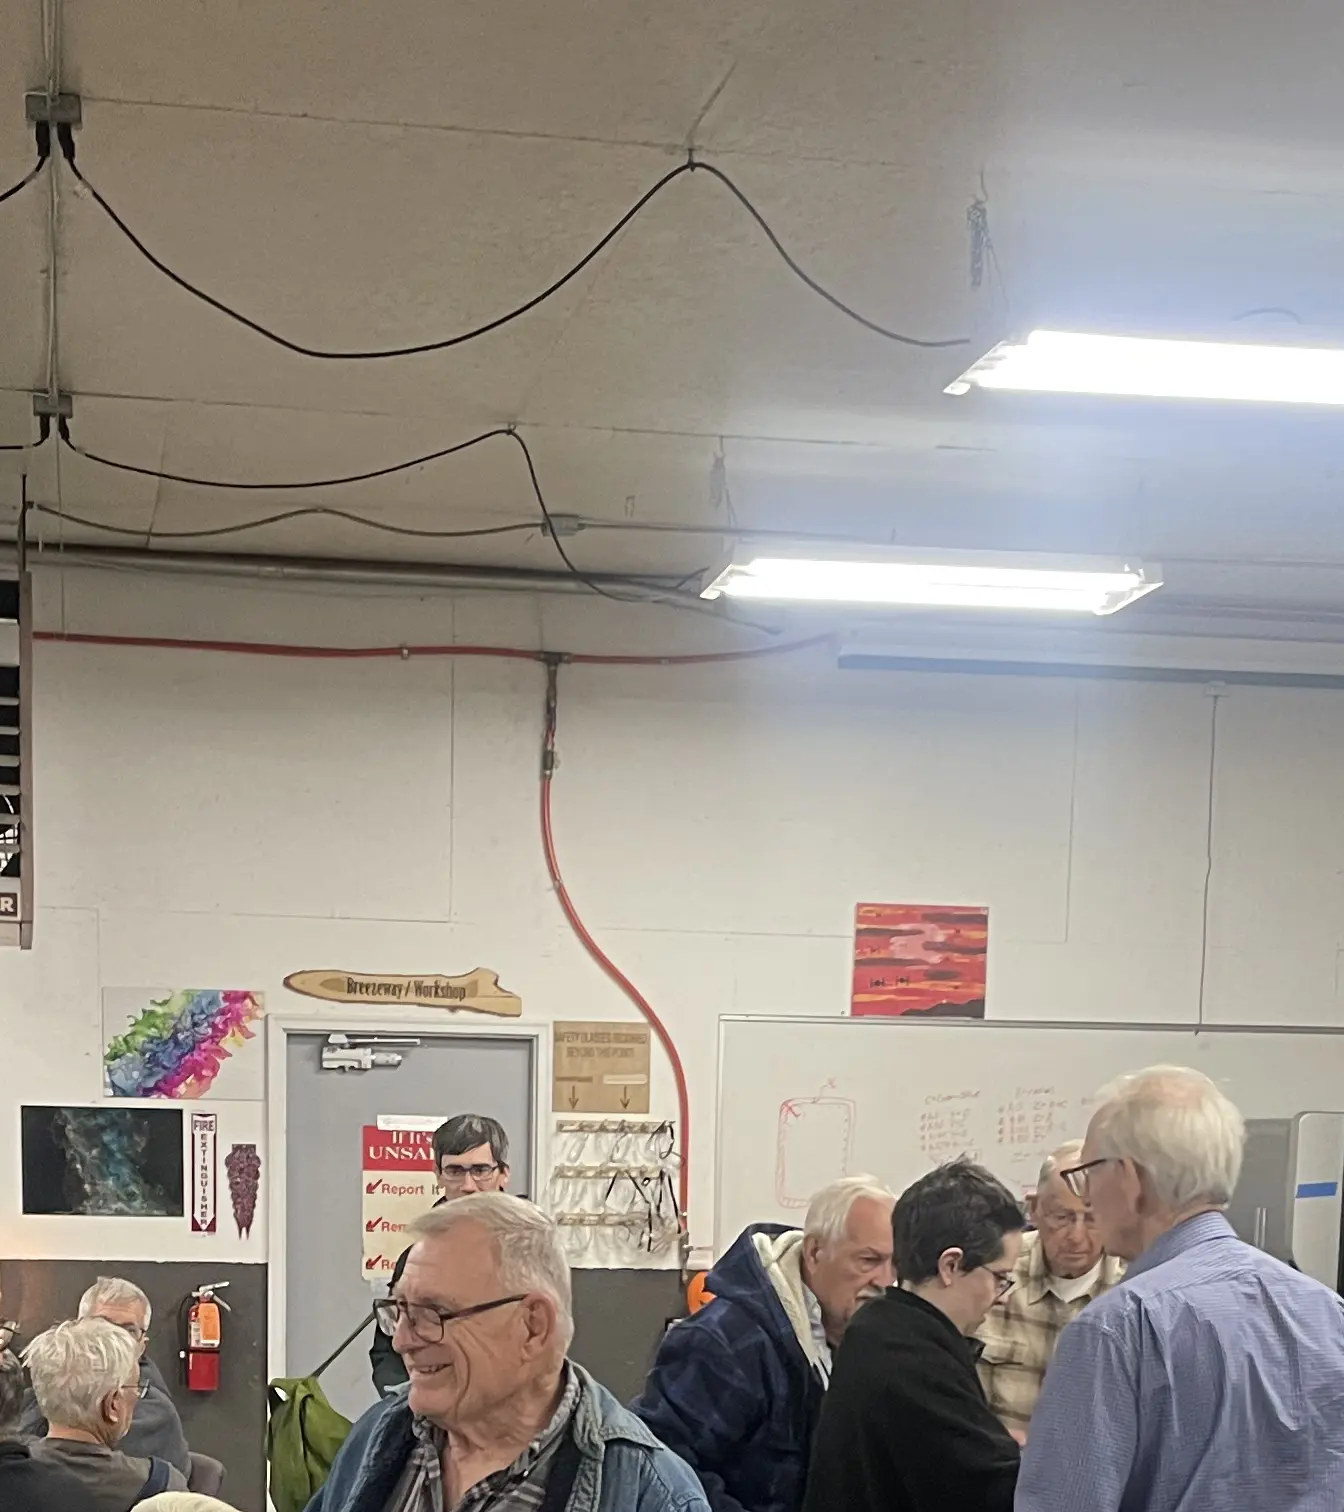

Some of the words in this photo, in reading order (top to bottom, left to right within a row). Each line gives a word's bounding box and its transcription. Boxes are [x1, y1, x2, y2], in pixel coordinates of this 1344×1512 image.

[346, 976, 404, 1000] Breezeway
[414, 979, 466, 1002] Workshop
[194, 1121, 214, 1132] FIRE
[392, 1131, 404, 1144] If
[381, 1184, 424, 1197] Report
